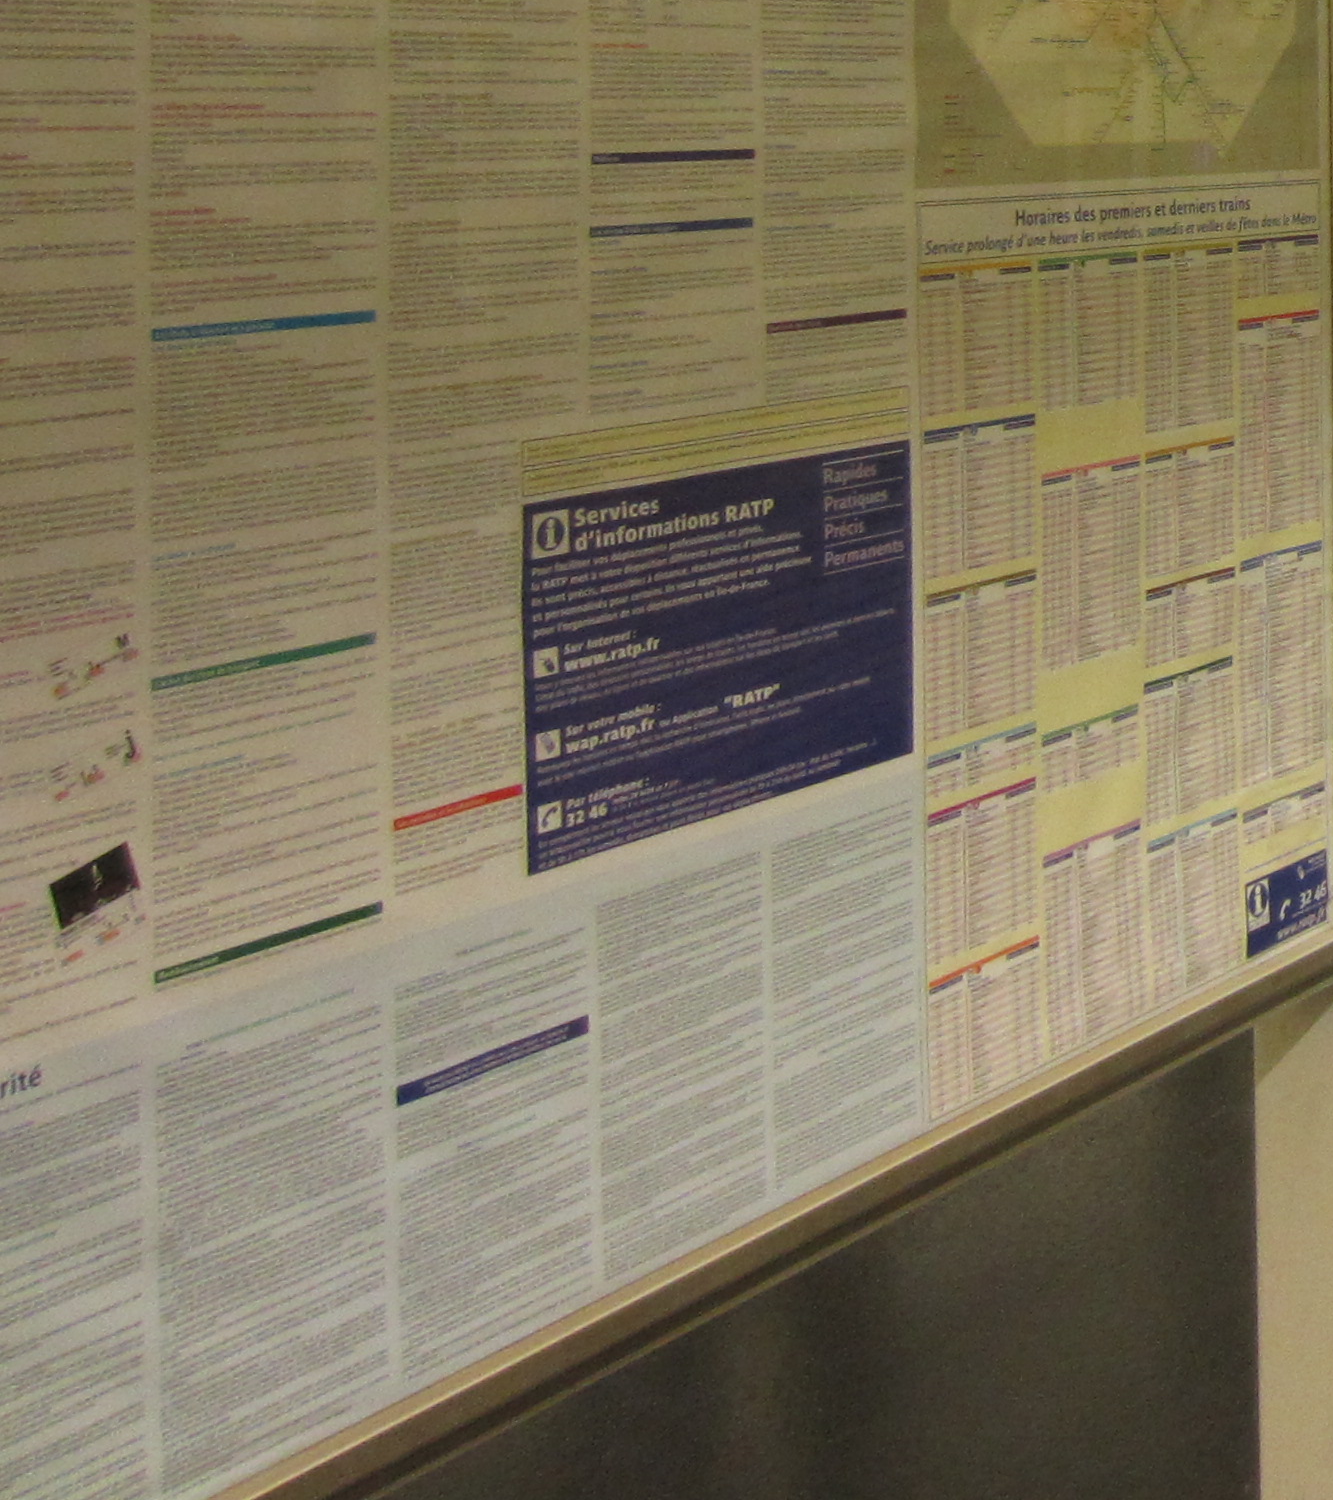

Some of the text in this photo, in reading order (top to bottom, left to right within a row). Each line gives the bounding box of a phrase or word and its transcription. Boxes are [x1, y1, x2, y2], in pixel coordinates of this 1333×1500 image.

[1015, 196, 1251, 227] Horaires des premiers et derniers trains
[925, 239, 965, 257] Service
[966, 233, 1014, 255] prolongé
[1017, 233, 1047, 250] d'une
[1051, 232, 1078, 245] heure
[1147, 221, 1184, 238] samedis
[823, 463, 878, 486] Rapides
[574, 500, 660, 528] Services
[824, 489, 890, 513] Pratiques
[574, 498, 775, 551] d'informations RATP
[824, 518, 866, 540] Précis
[824, 539, 905, 568] Permanents
[564, 637, 661, 672] www.ratp.fr
[565, 717, 657, 754] wap.ratp.fr
[566, 802, 608, 827] 32 46
[1299, 881, 1327, 908] 32 46
[0, 1063, 43, 1100] rité
